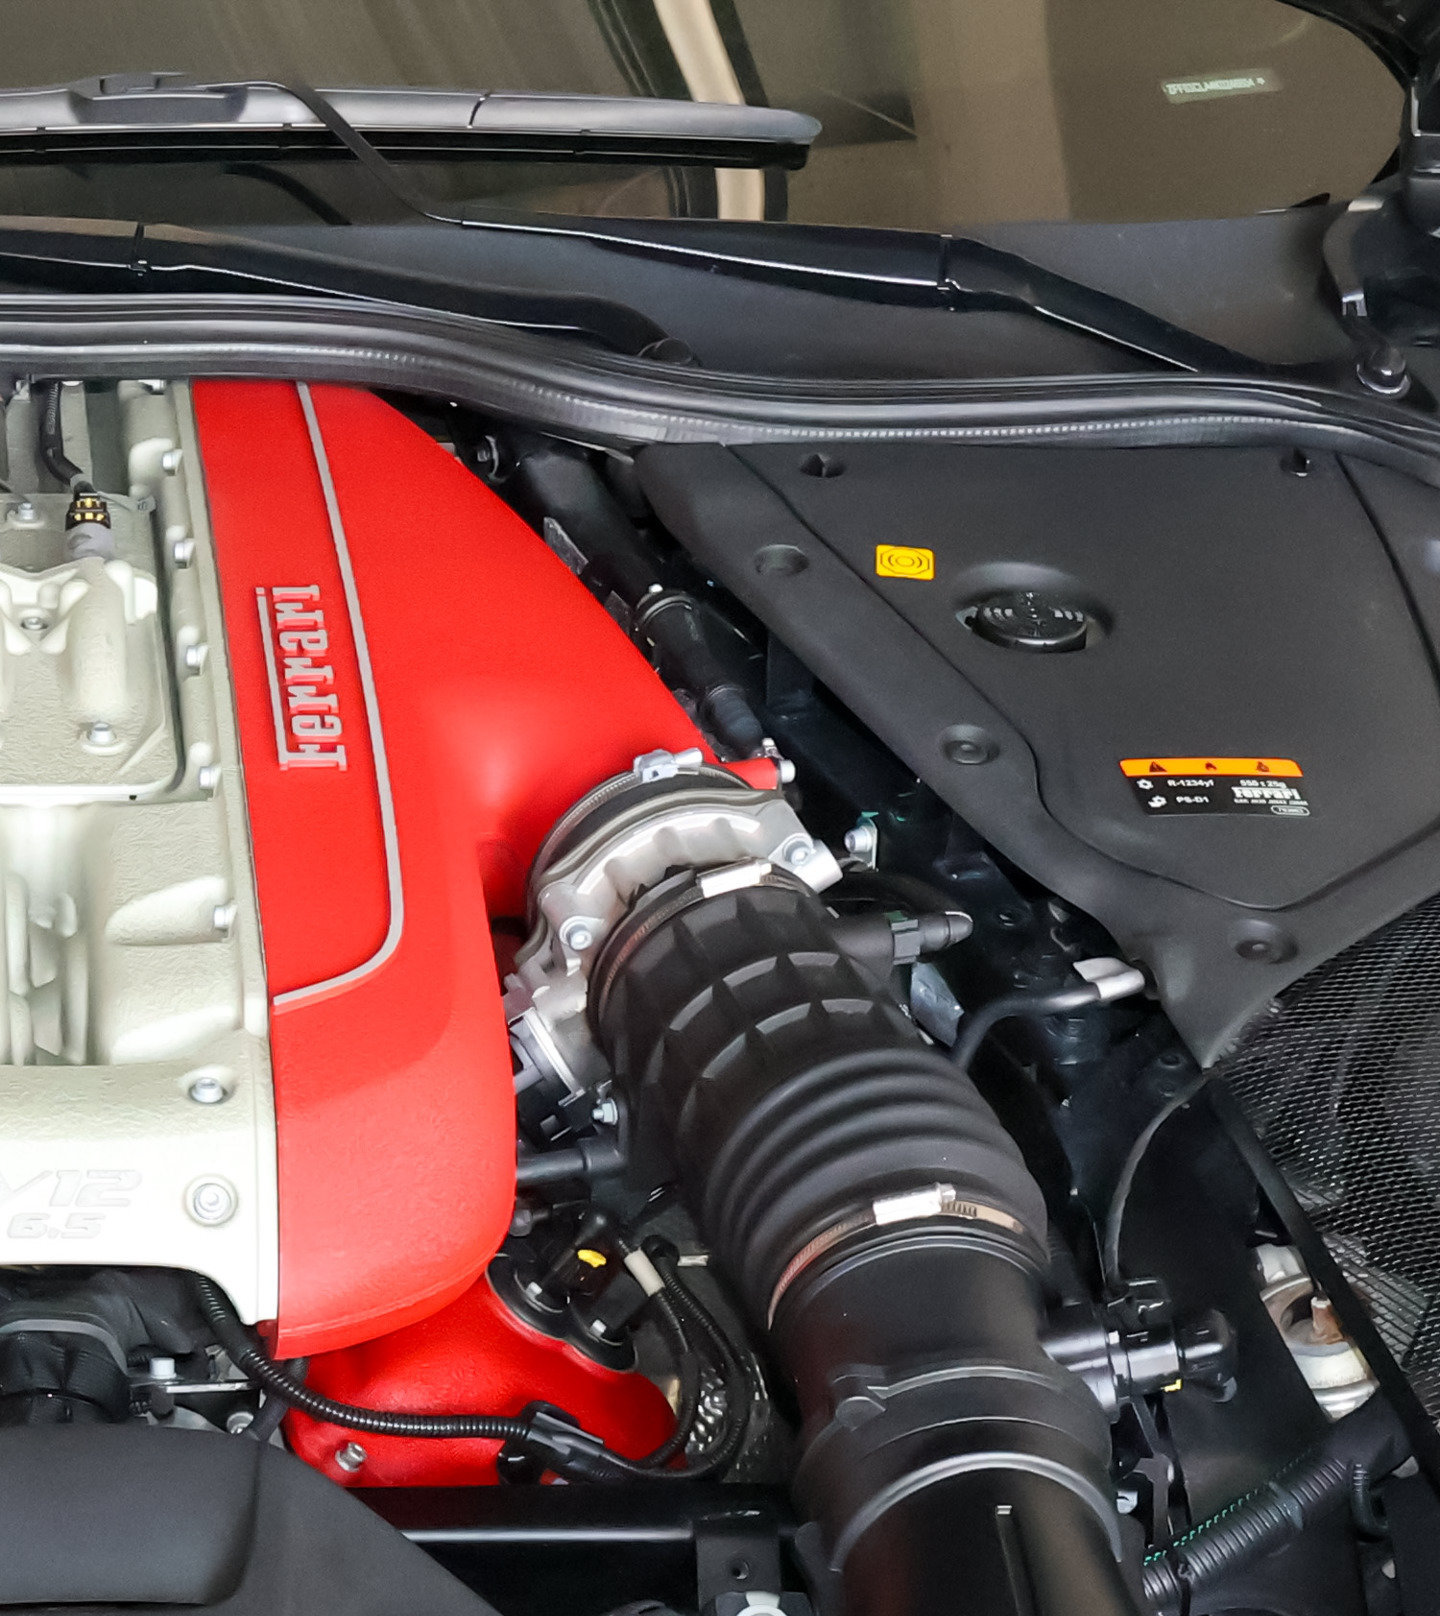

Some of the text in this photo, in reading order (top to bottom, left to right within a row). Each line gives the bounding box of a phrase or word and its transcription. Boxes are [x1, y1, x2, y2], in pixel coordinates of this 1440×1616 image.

[255, 585, 348, 771] Ferrari
[1231, 787, 1302, 800] Ferrari
[7, 1213, 106, 1239] 6.5
